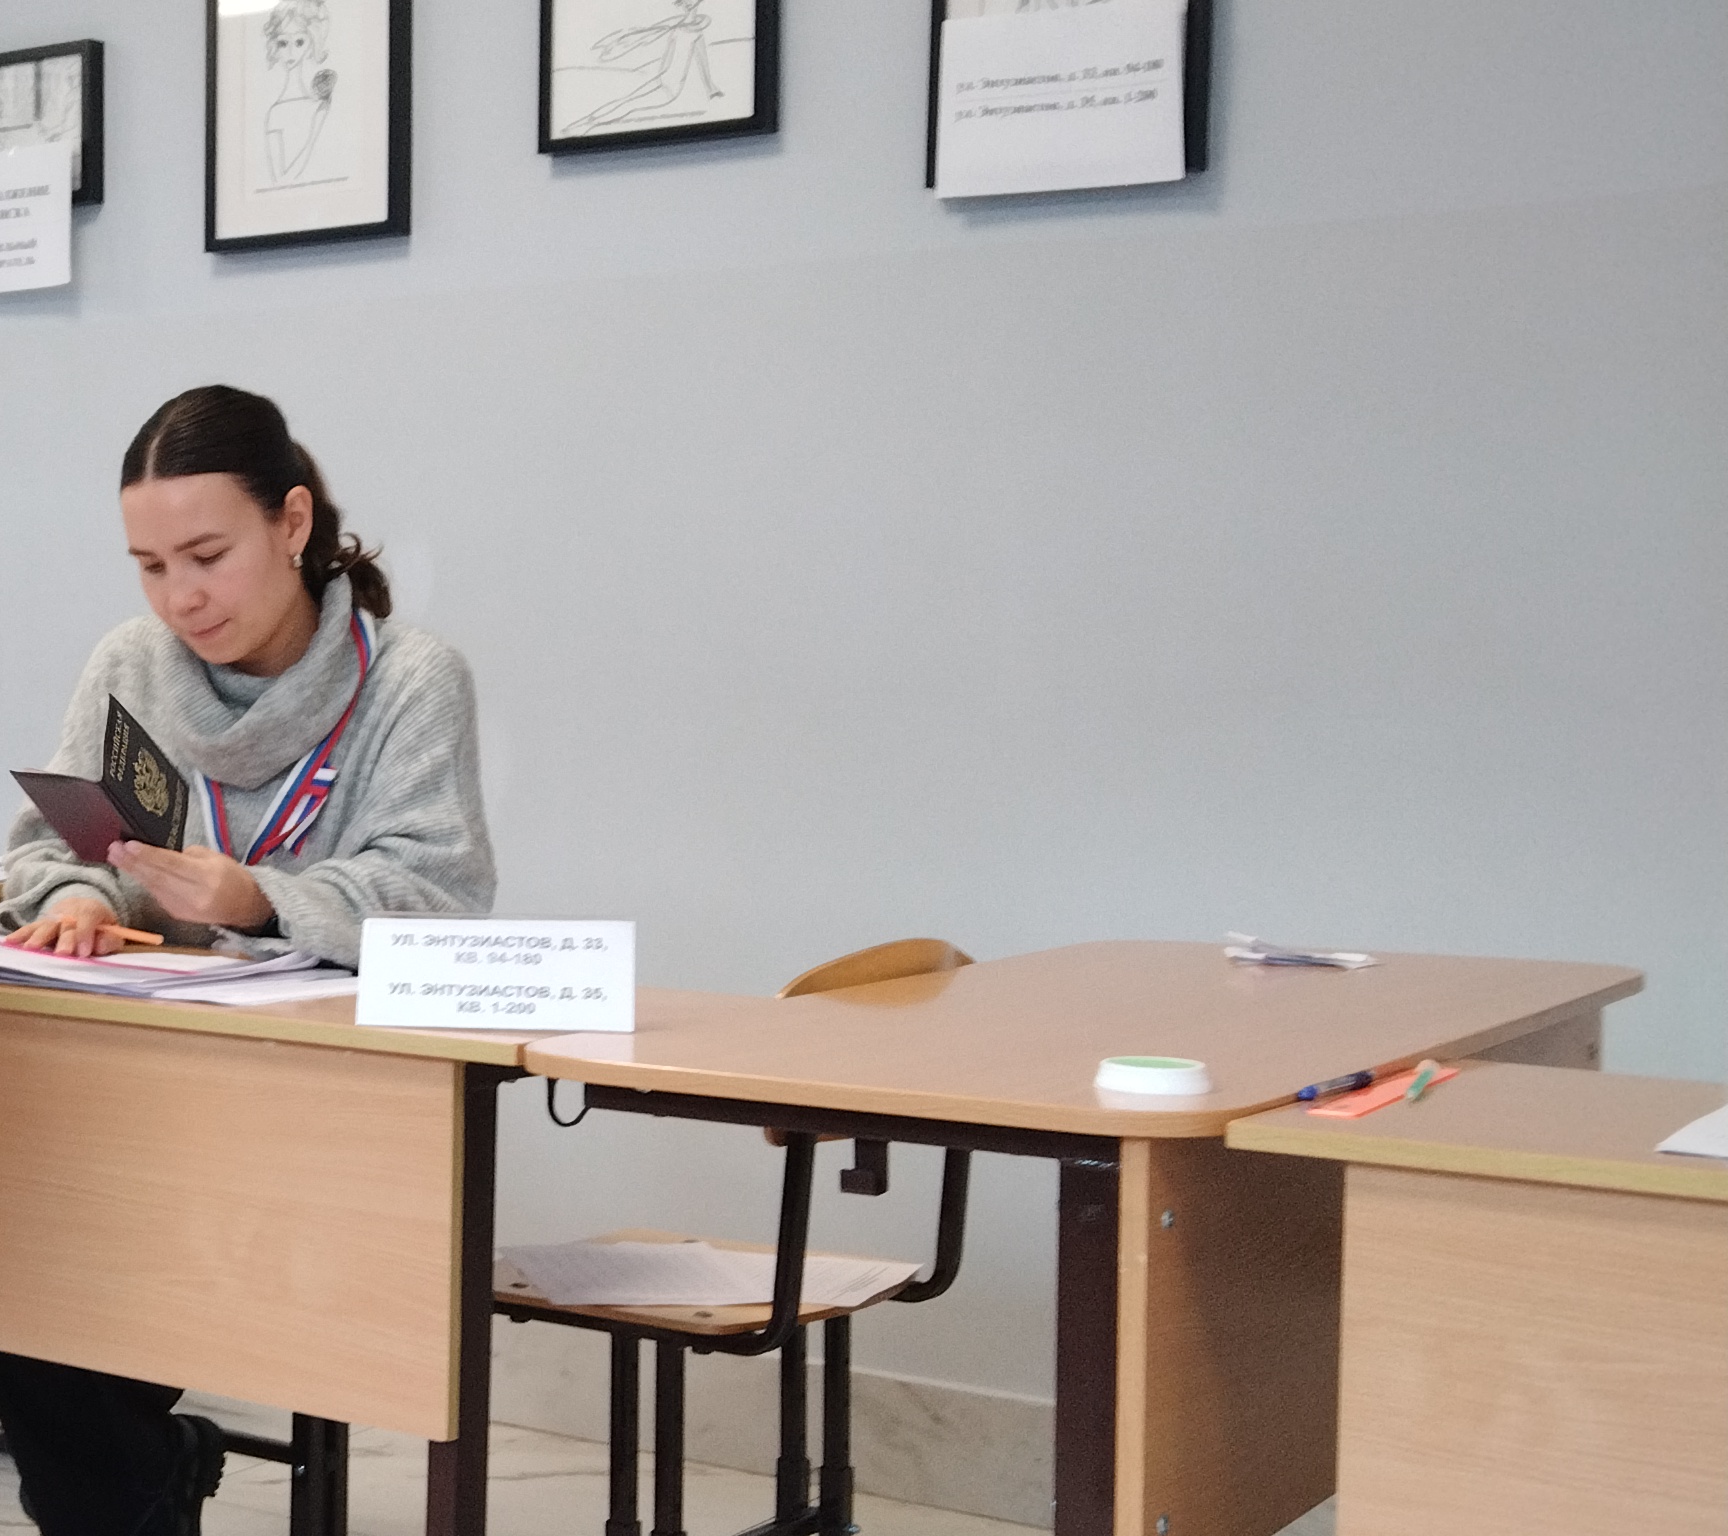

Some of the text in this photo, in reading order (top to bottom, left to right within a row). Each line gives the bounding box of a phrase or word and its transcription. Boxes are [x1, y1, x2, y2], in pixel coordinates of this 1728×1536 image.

[390, 933, 419, 946] УЛ.
[387, 982, 416, 995] УЛ.
[490, 1001, 536, 1015] 1-200
